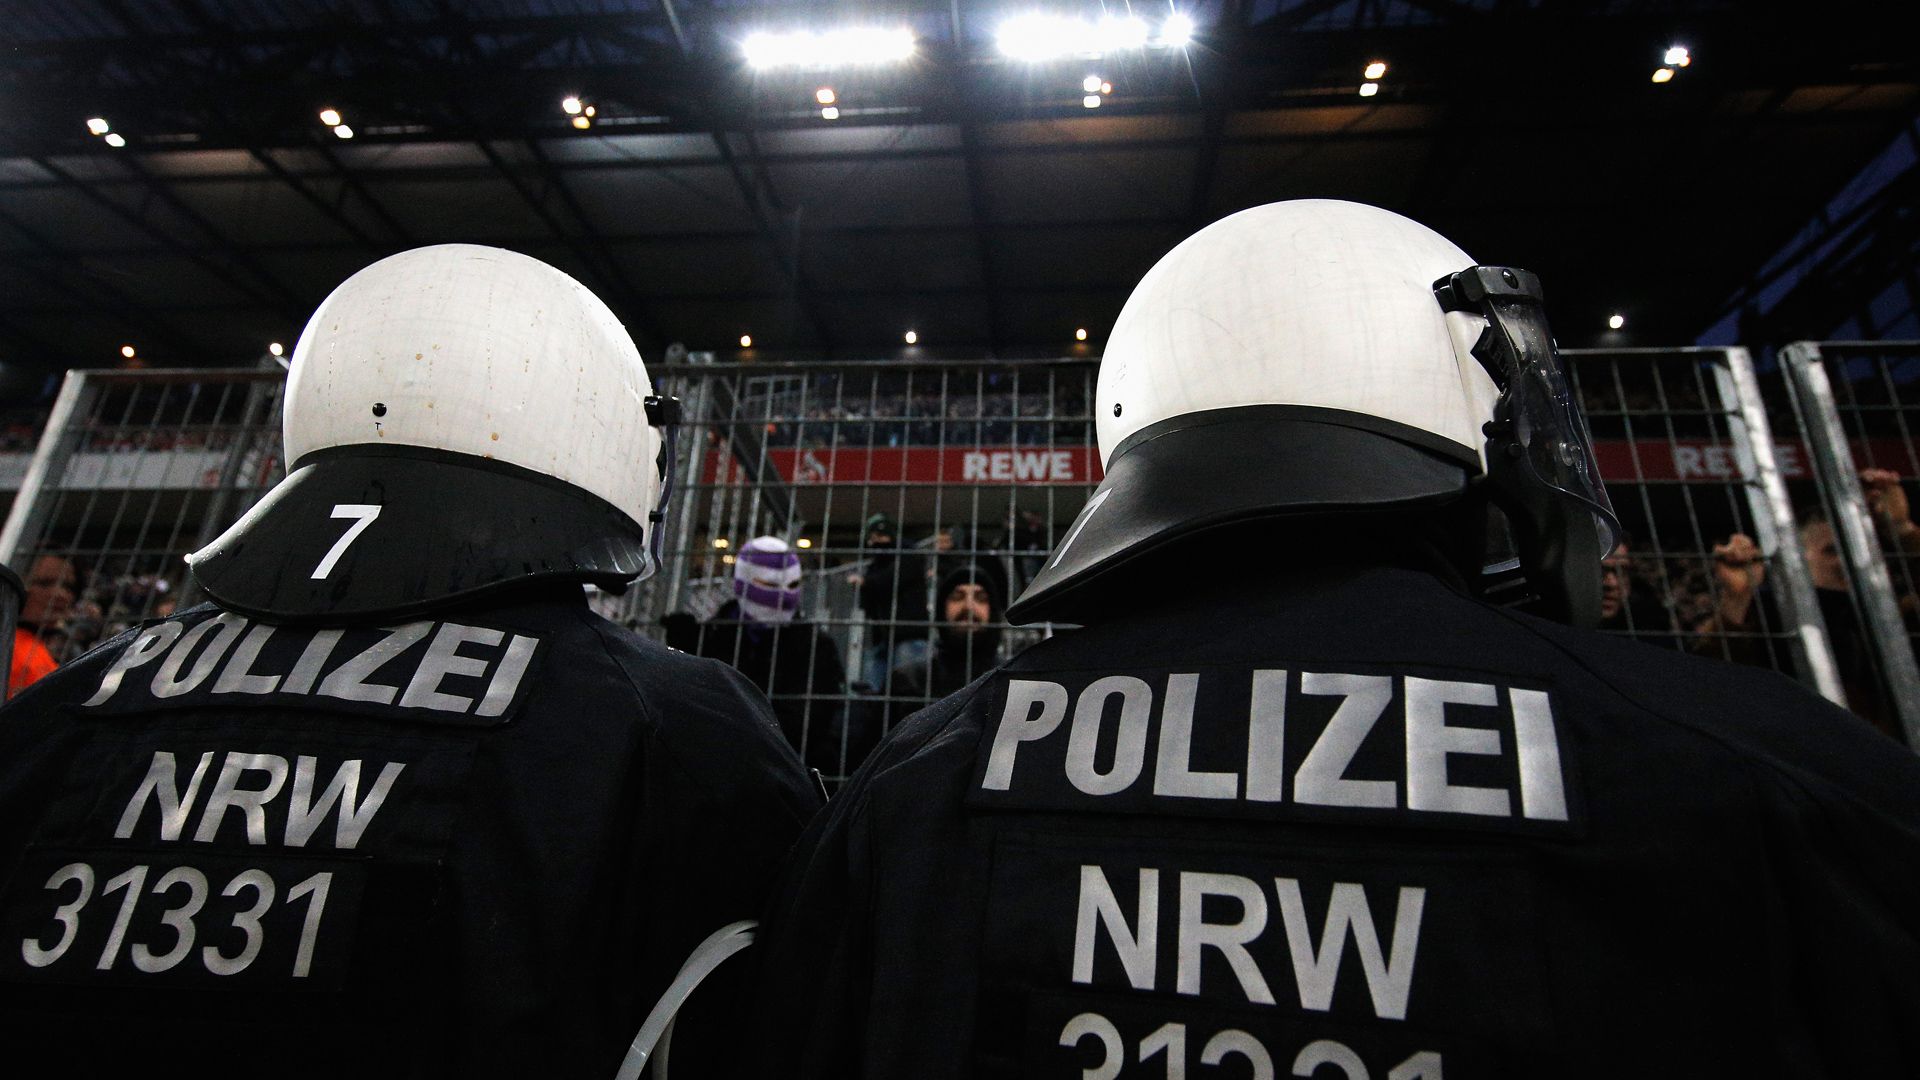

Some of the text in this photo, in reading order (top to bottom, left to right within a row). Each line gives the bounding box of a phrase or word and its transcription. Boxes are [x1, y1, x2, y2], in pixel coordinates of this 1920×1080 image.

[962, 451, 1074, 480] REWE
[1674, 445, 1804, 476] REE
[311, 505, 382, 580] 7
[82, 611, 540, 717] POLIZEI
[982, 669, 1569, 821] POLIZEI
[114, 751, 406, 849] NRW
[21, 862, 333, 978] 31331
[1072, 864, 1426, 1020] NRW
